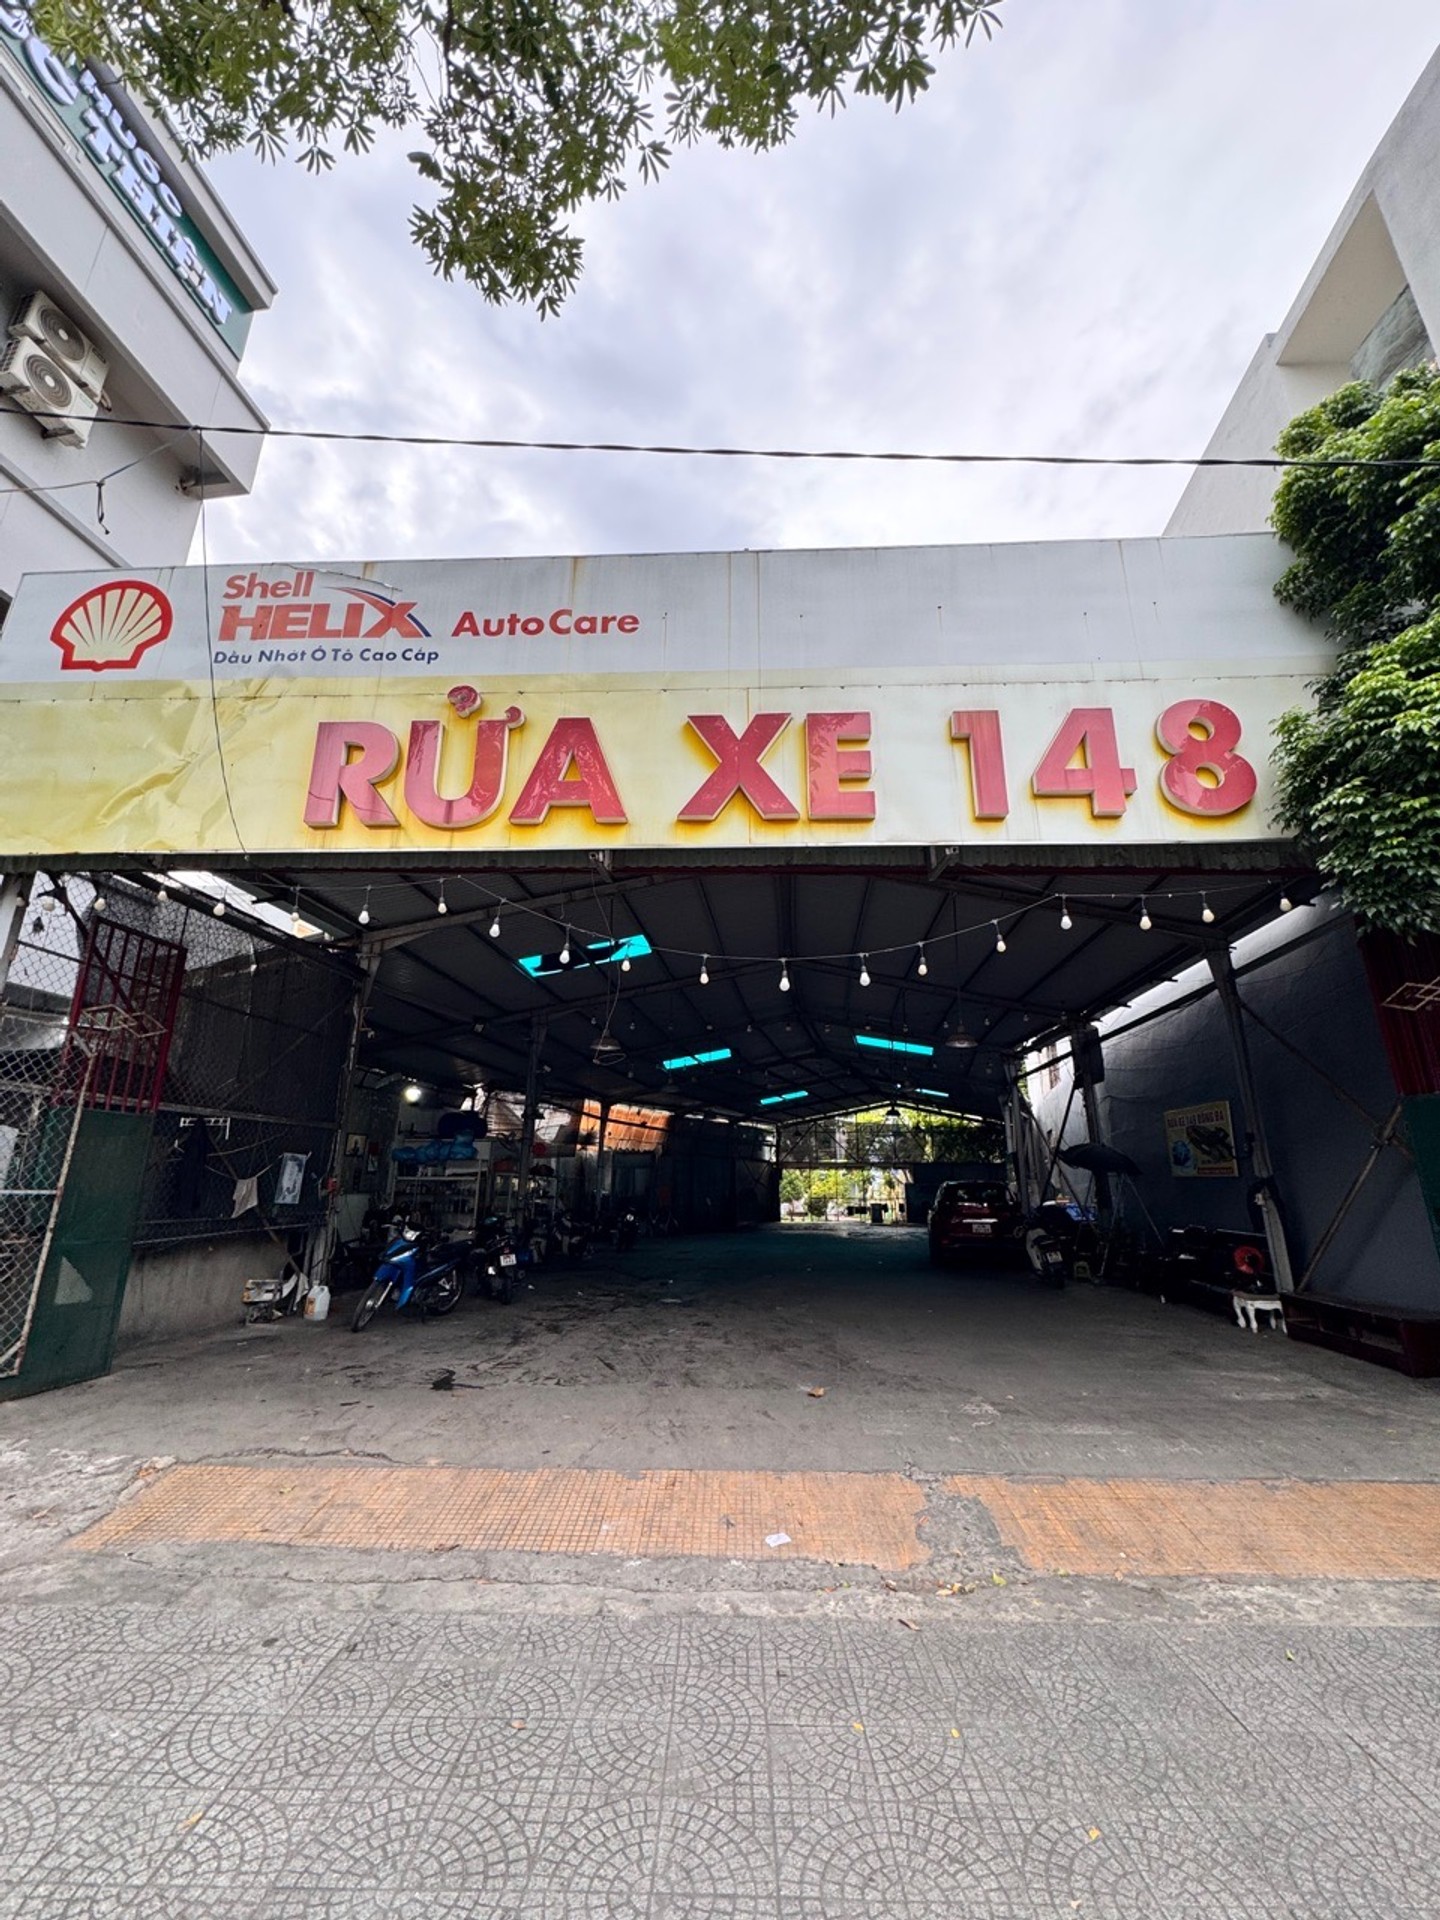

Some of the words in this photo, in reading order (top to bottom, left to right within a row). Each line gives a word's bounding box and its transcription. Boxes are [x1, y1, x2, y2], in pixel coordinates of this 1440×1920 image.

[222, 571, 315, 600] Shell
[217, 590, 424, 641] HELIX
[360, 648, 397, 662] Cao
[303, 685, 628, 831] RỬA
[676, 711, 877, 821] XE
[949, 699, 1258, 819] 148
